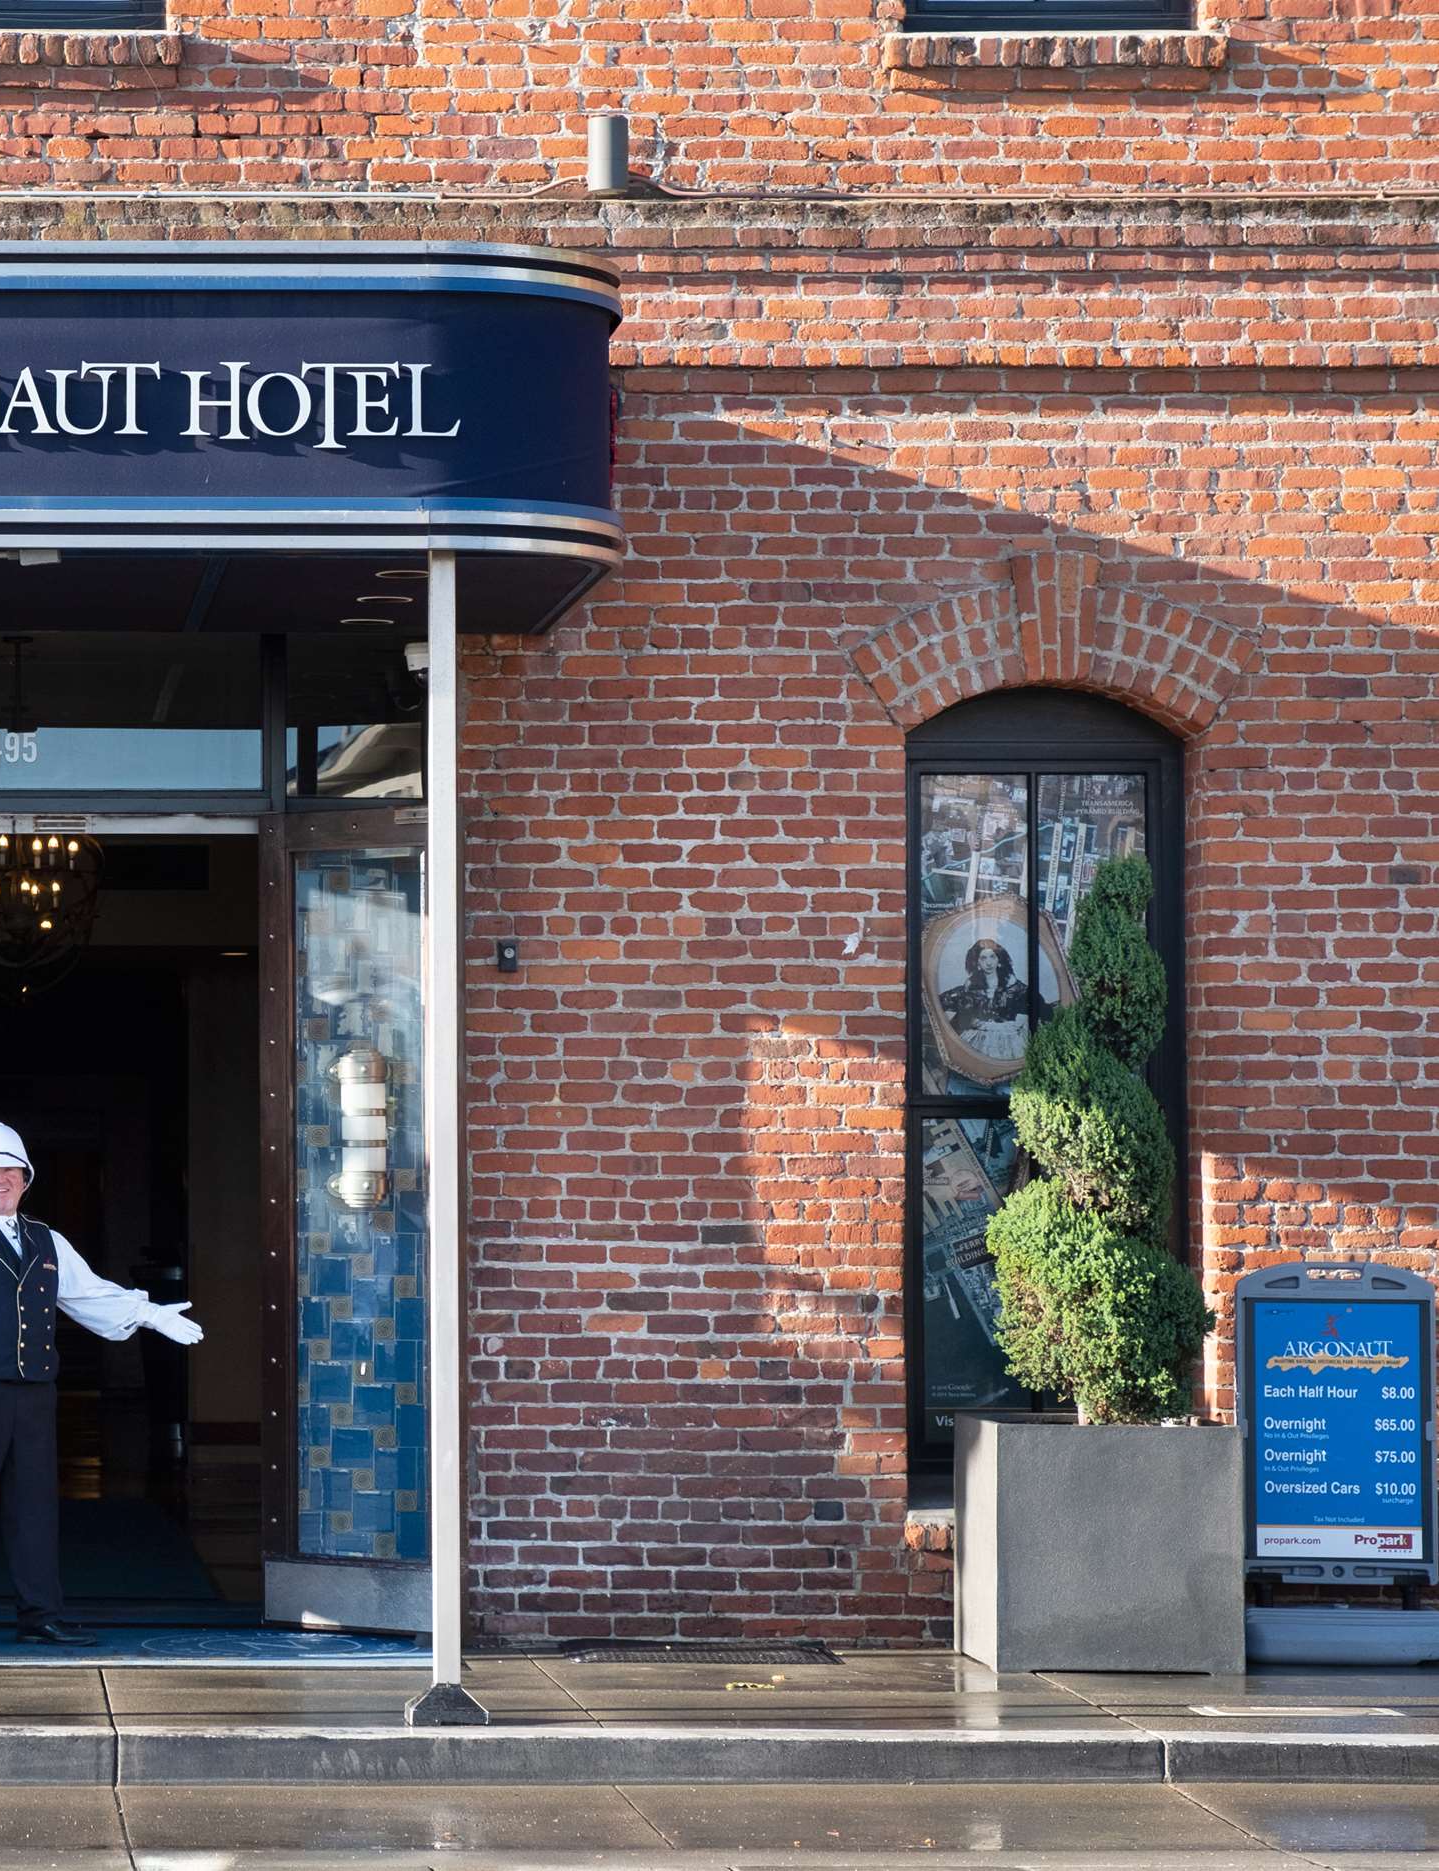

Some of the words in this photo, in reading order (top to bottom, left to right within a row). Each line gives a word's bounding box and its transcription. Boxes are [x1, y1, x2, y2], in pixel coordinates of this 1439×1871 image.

[179, 361, 462, 450] HOTEL
[959, 1237, 985, 1251] FERRY
[1283, 1340, 1393, 1358] ARGONAUT
[1264, 1385, 1296, 1399] Each
[1298, 1386, 1324, 1399] Half
[1327, 1386, 1358, 1399] Hour
[1381, 1386, 1415, 1400] $8.00
[1264, 1416, 1326, 1433] Overnight
[1374, 1418, 1416, 1433] $65.00
[1264, 1448, 1327, 1465] Overnight
[1374, 1450, 1416, 1465] $75.00
[1264, 1480, 1328, 1495] Oversized
[1331, 1481, 1361, 1495] Cars
[1375, 1482, 1416, 1497] $10.00
[1381, 1497, 1414, 1505] surcharge
[1264, 1536, 1321, 1546] propark.com
[1354, 1533, 1408, 1548] Propark
